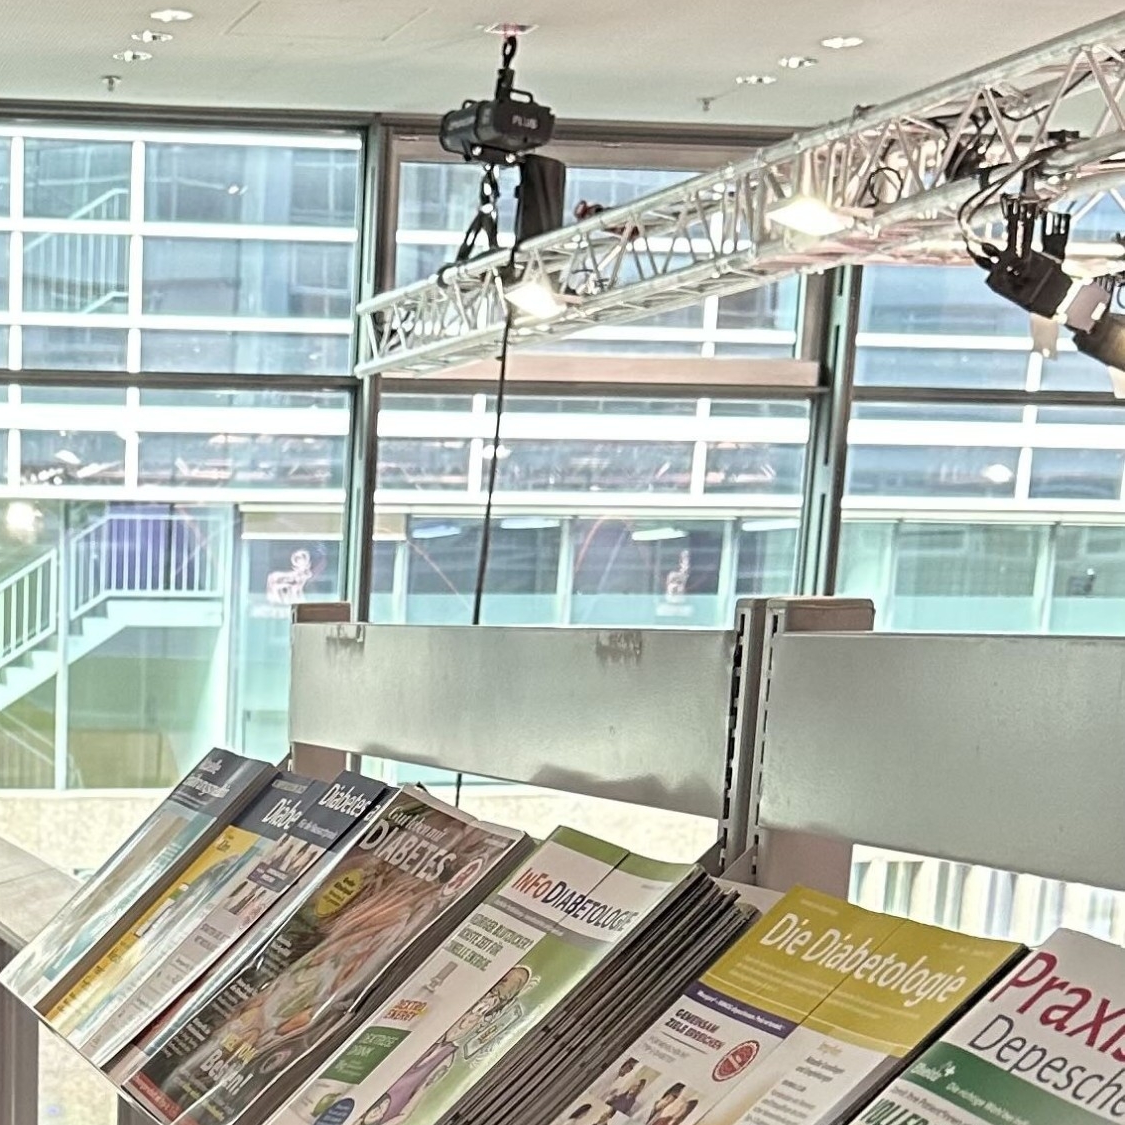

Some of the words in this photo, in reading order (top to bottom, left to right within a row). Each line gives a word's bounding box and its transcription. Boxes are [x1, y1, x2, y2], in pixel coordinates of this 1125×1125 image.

[258, 796, 313, 830] Diabe
[316, 783, 373, 817] Diabetes
[385, 805, 414, 826] Gut
[358, 819, 457, 882] DIABETES
[758, 912, 814, 955] Die
[800, 927, 969, 1006] Diabetologie
[988, 951, 1125, 1062] Praxi
